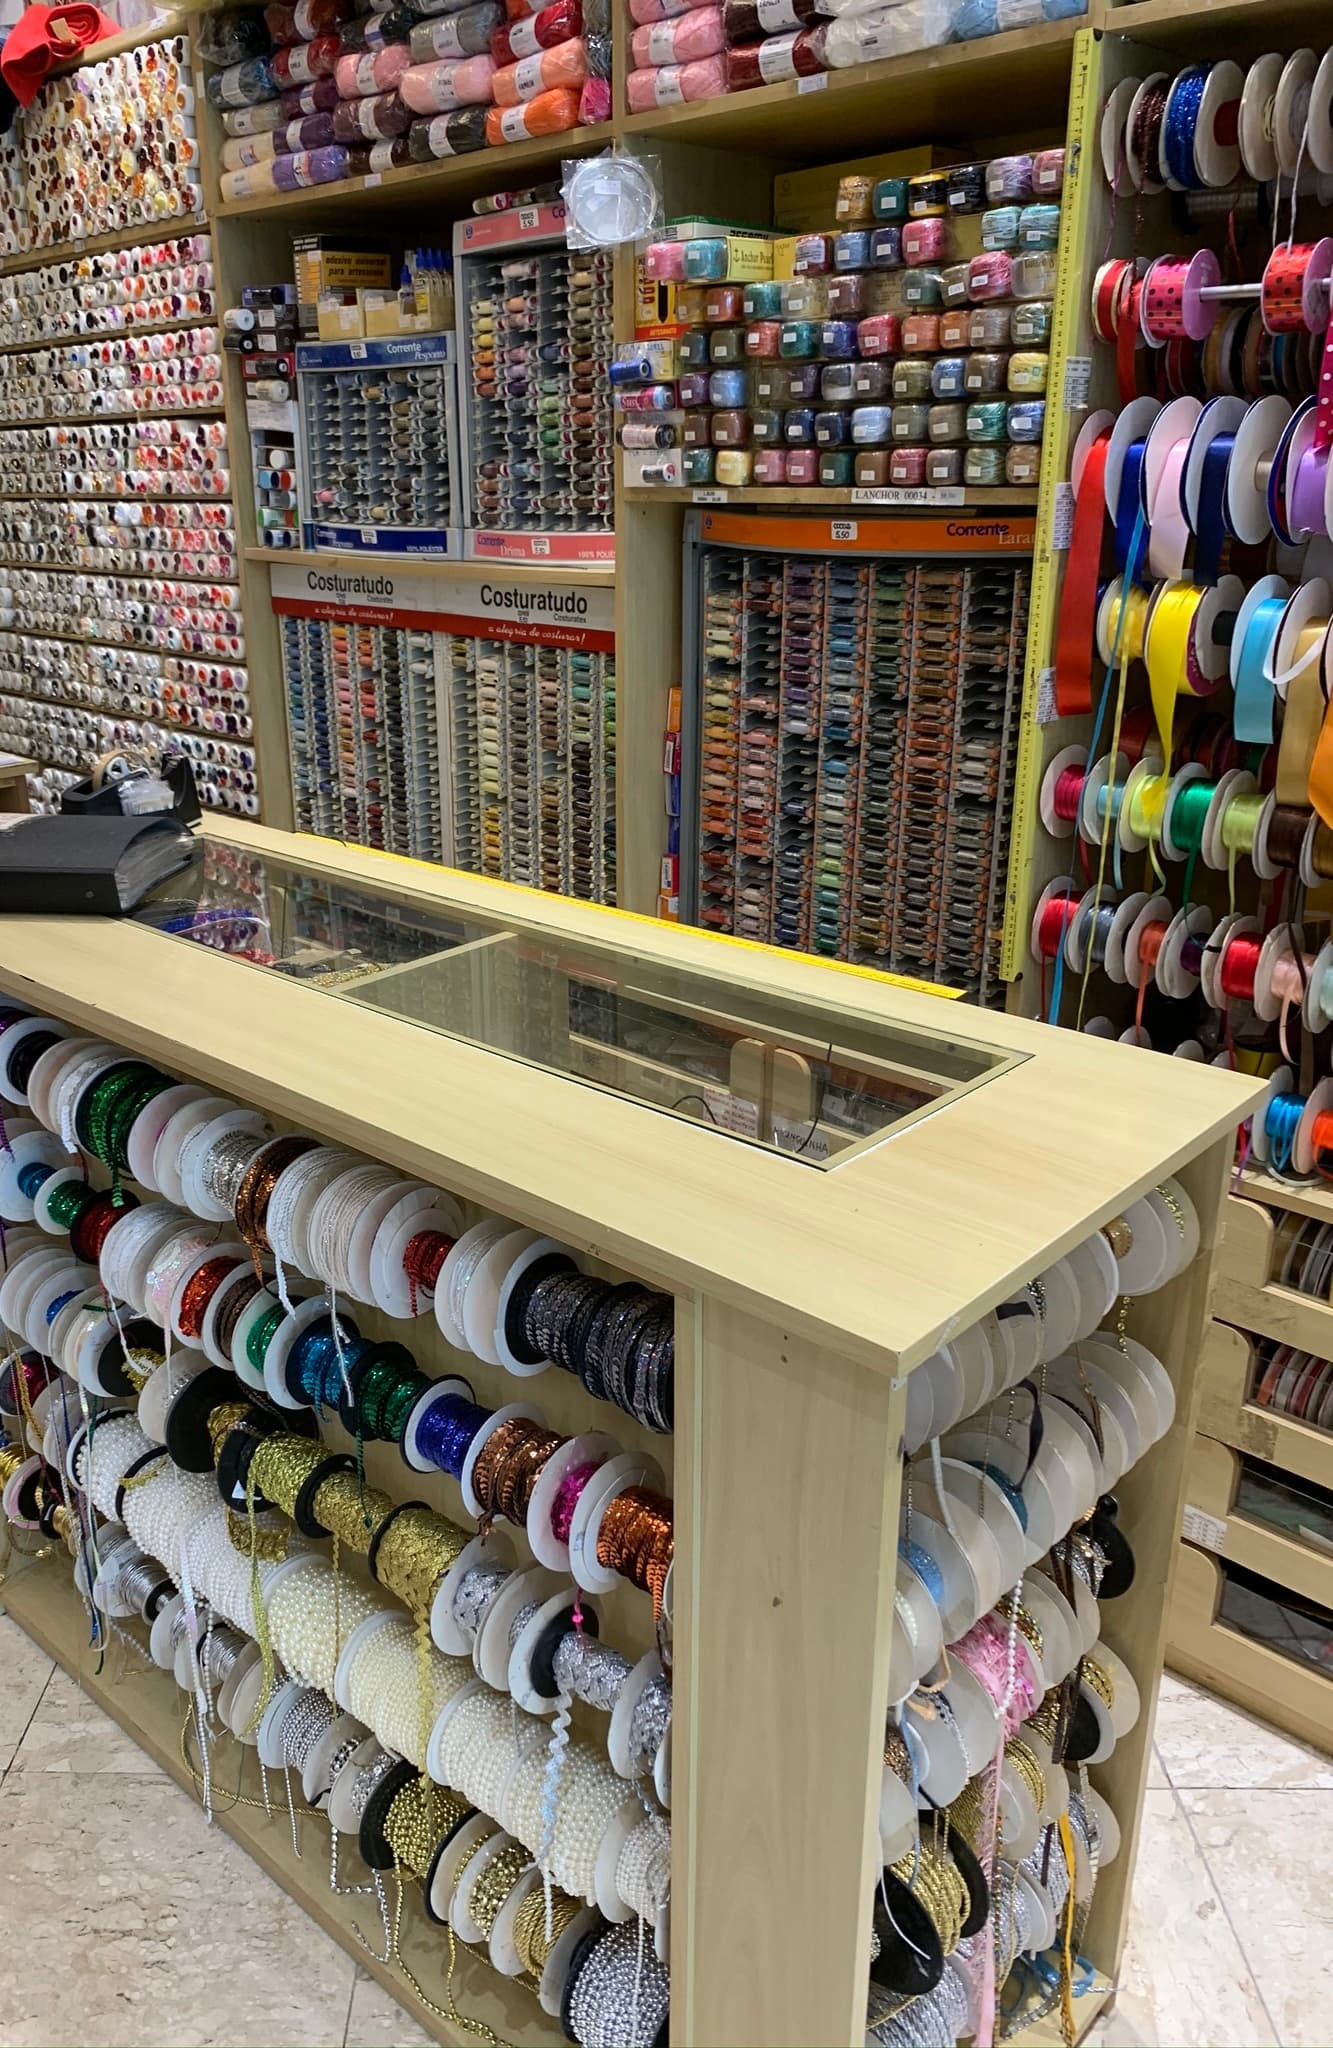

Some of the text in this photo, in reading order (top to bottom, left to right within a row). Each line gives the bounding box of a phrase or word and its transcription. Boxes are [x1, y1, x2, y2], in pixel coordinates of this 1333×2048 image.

[386, 342, 422, 354] Corrente
[946, 522, 1010, 537] Corrente
[500, 545, 526, 557] Drima
[306, 570, 394, 596] Costuratudo
[480, 584, 588, 614] Costuratudo
